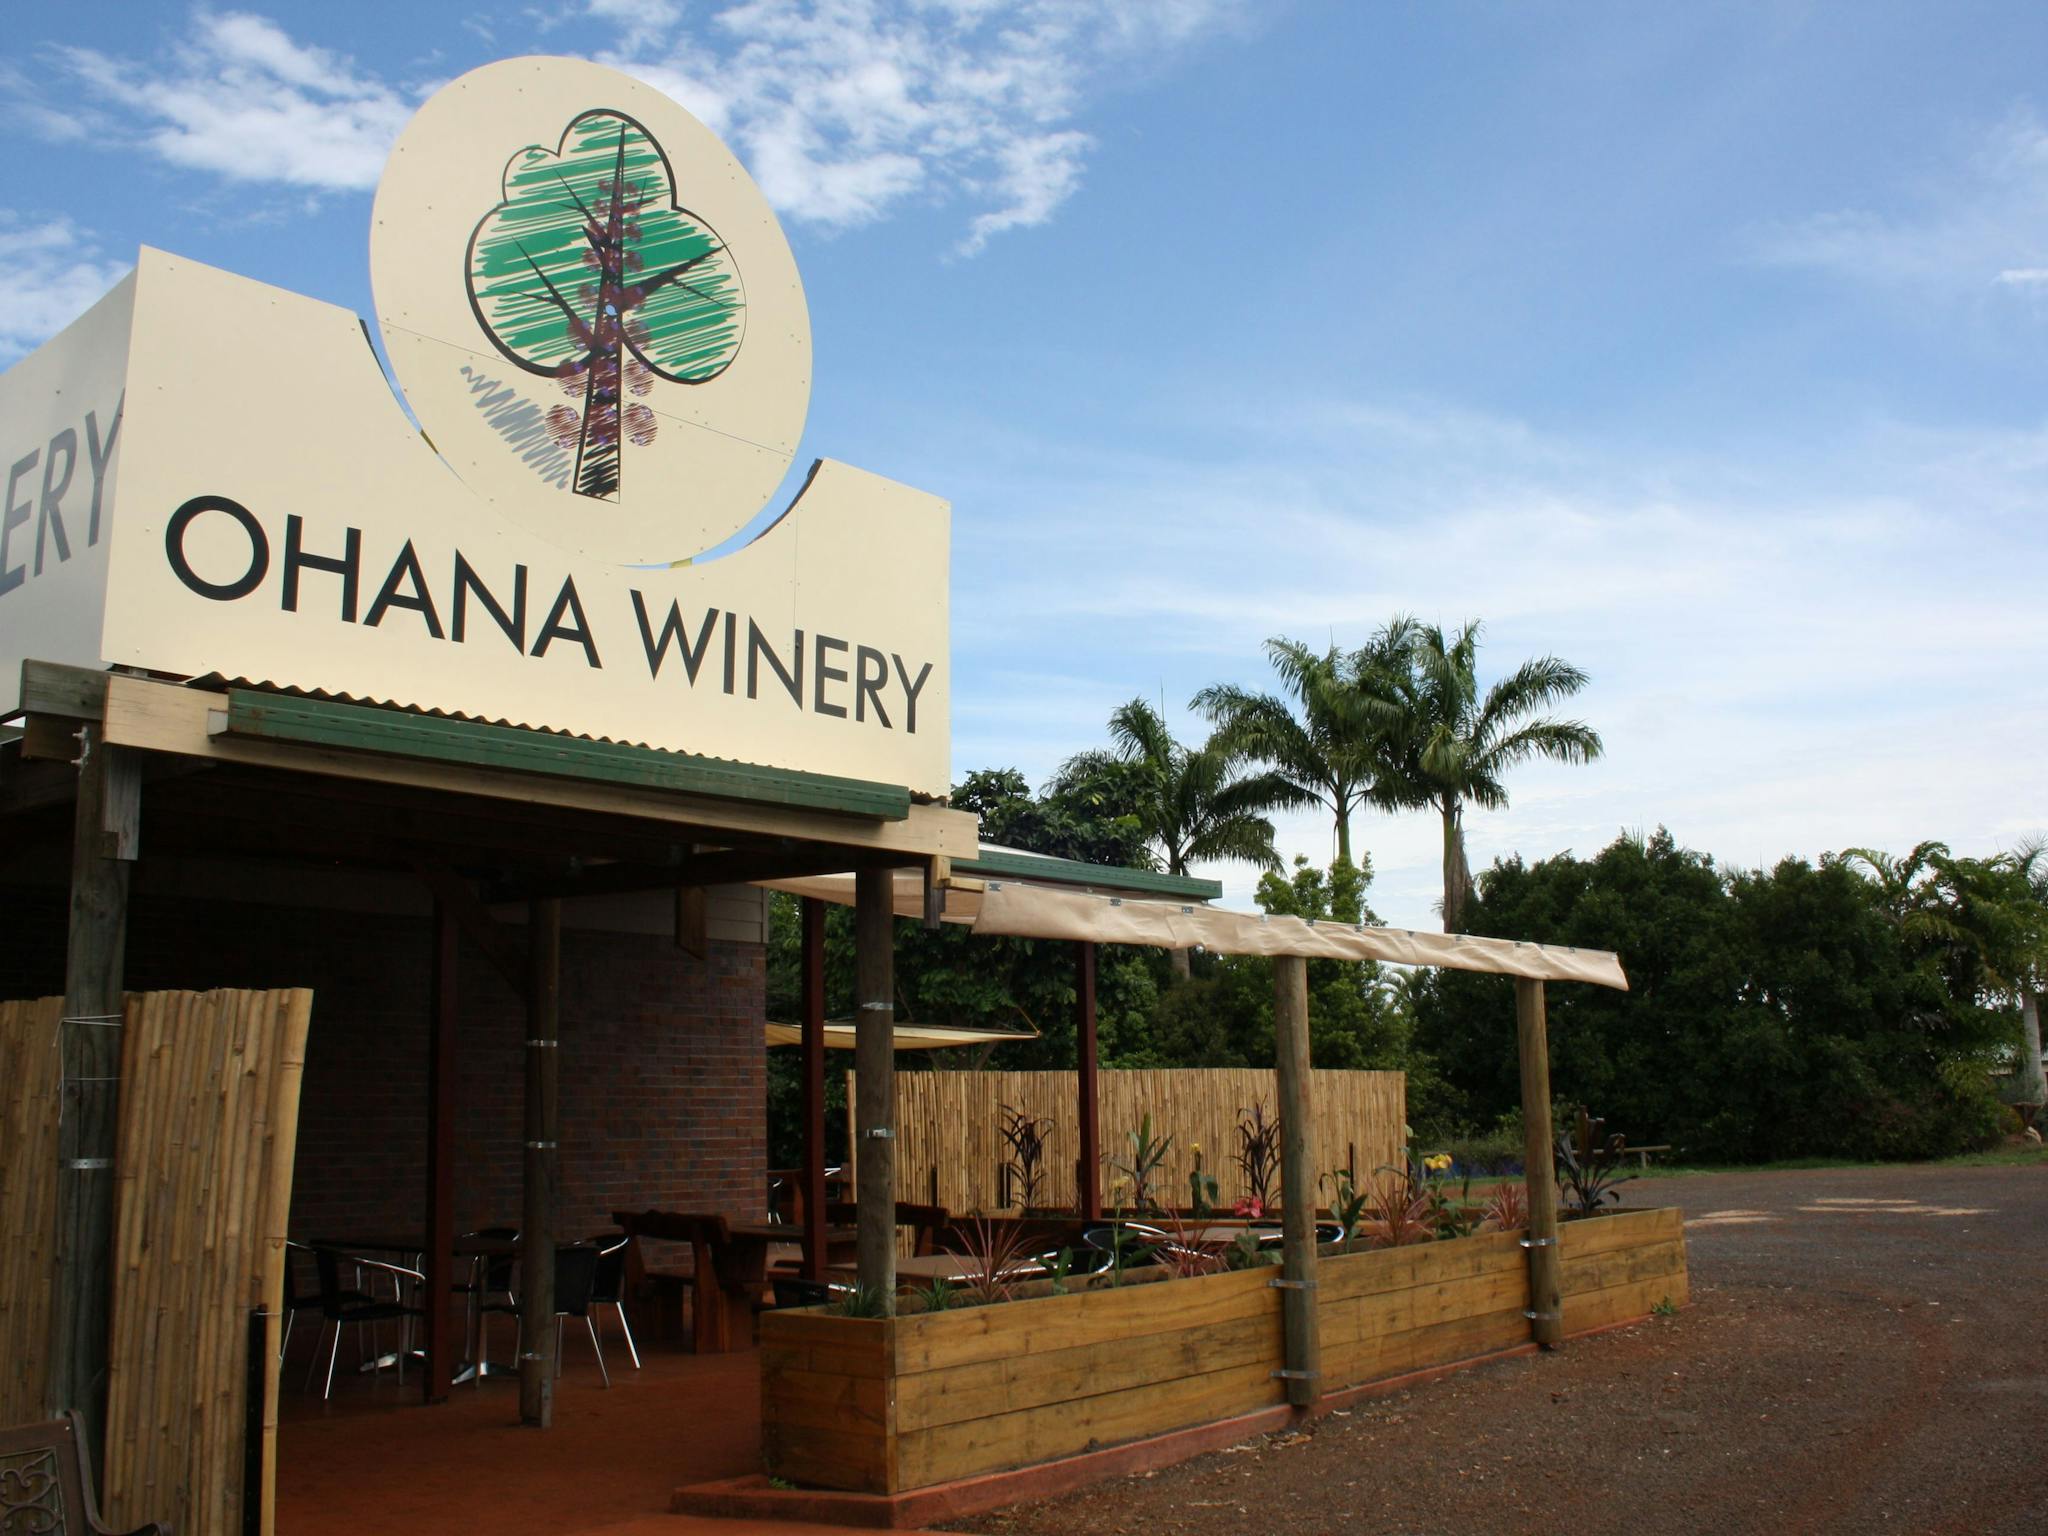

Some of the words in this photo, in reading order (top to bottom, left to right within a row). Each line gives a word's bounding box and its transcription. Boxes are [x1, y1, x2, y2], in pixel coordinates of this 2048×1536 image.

[0, 387, 125, 597] ERY
[165, 495, 602, 670] OHANA
[630, 589, 933, 734] WINERY
